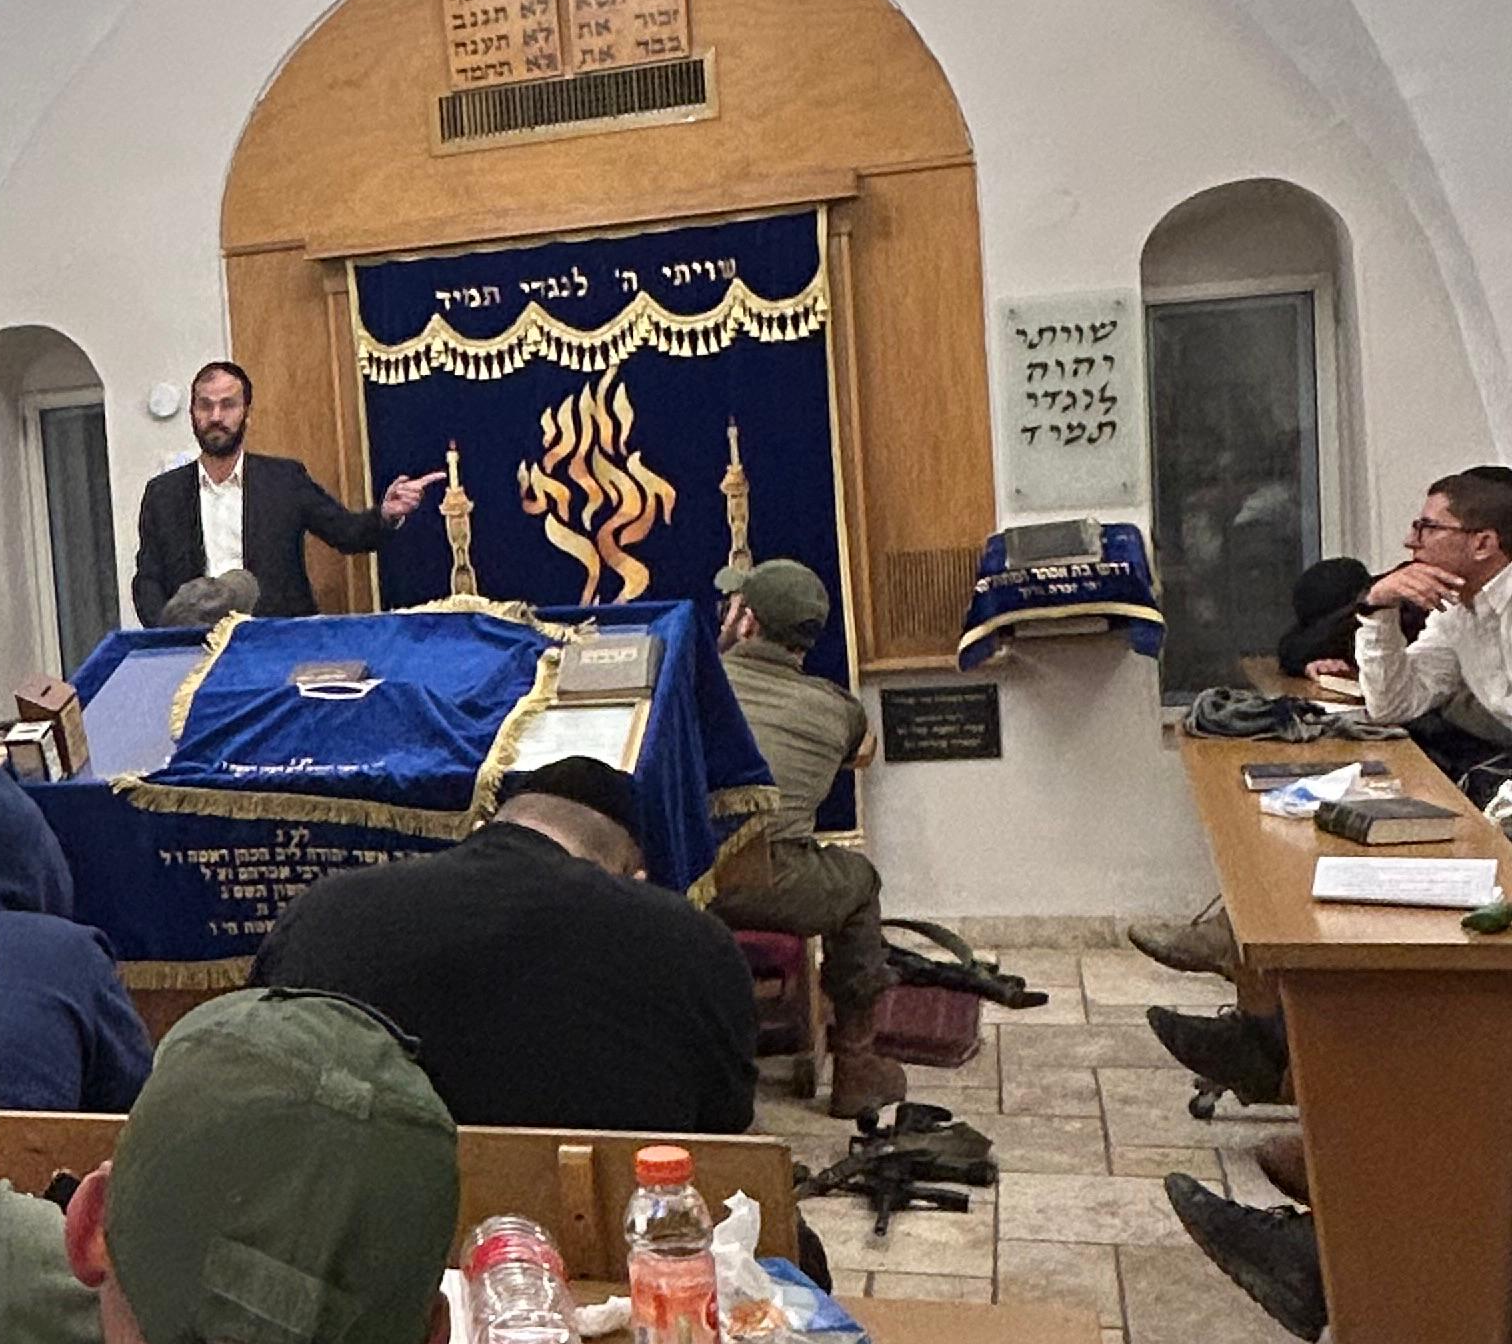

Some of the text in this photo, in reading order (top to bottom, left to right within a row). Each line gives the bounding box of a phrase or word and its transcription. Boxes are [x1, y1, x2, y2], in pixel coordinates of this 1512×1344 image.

[452, 6, 508, 30] תגנב
[578, 8, 680, 40] זכור את
[454, 20, 554, 57] לא תענה
[577, 35, 682, 69] כבד את
[525, 47, 559, 73] לא
[519, 266, 588, 300] לנגדי
[661, 256, 737, 288] שויתי
[435, 286, 502, 312] תמיד
[1016, 320, 1118, 349] שויתי
[1026, 355, 1116, 383] יהוה
[1026, 380, 1118, 416] לנגדי
[1021, 420, 1117, 446] תמיד
[238, 865, 291, 881] אברהם
